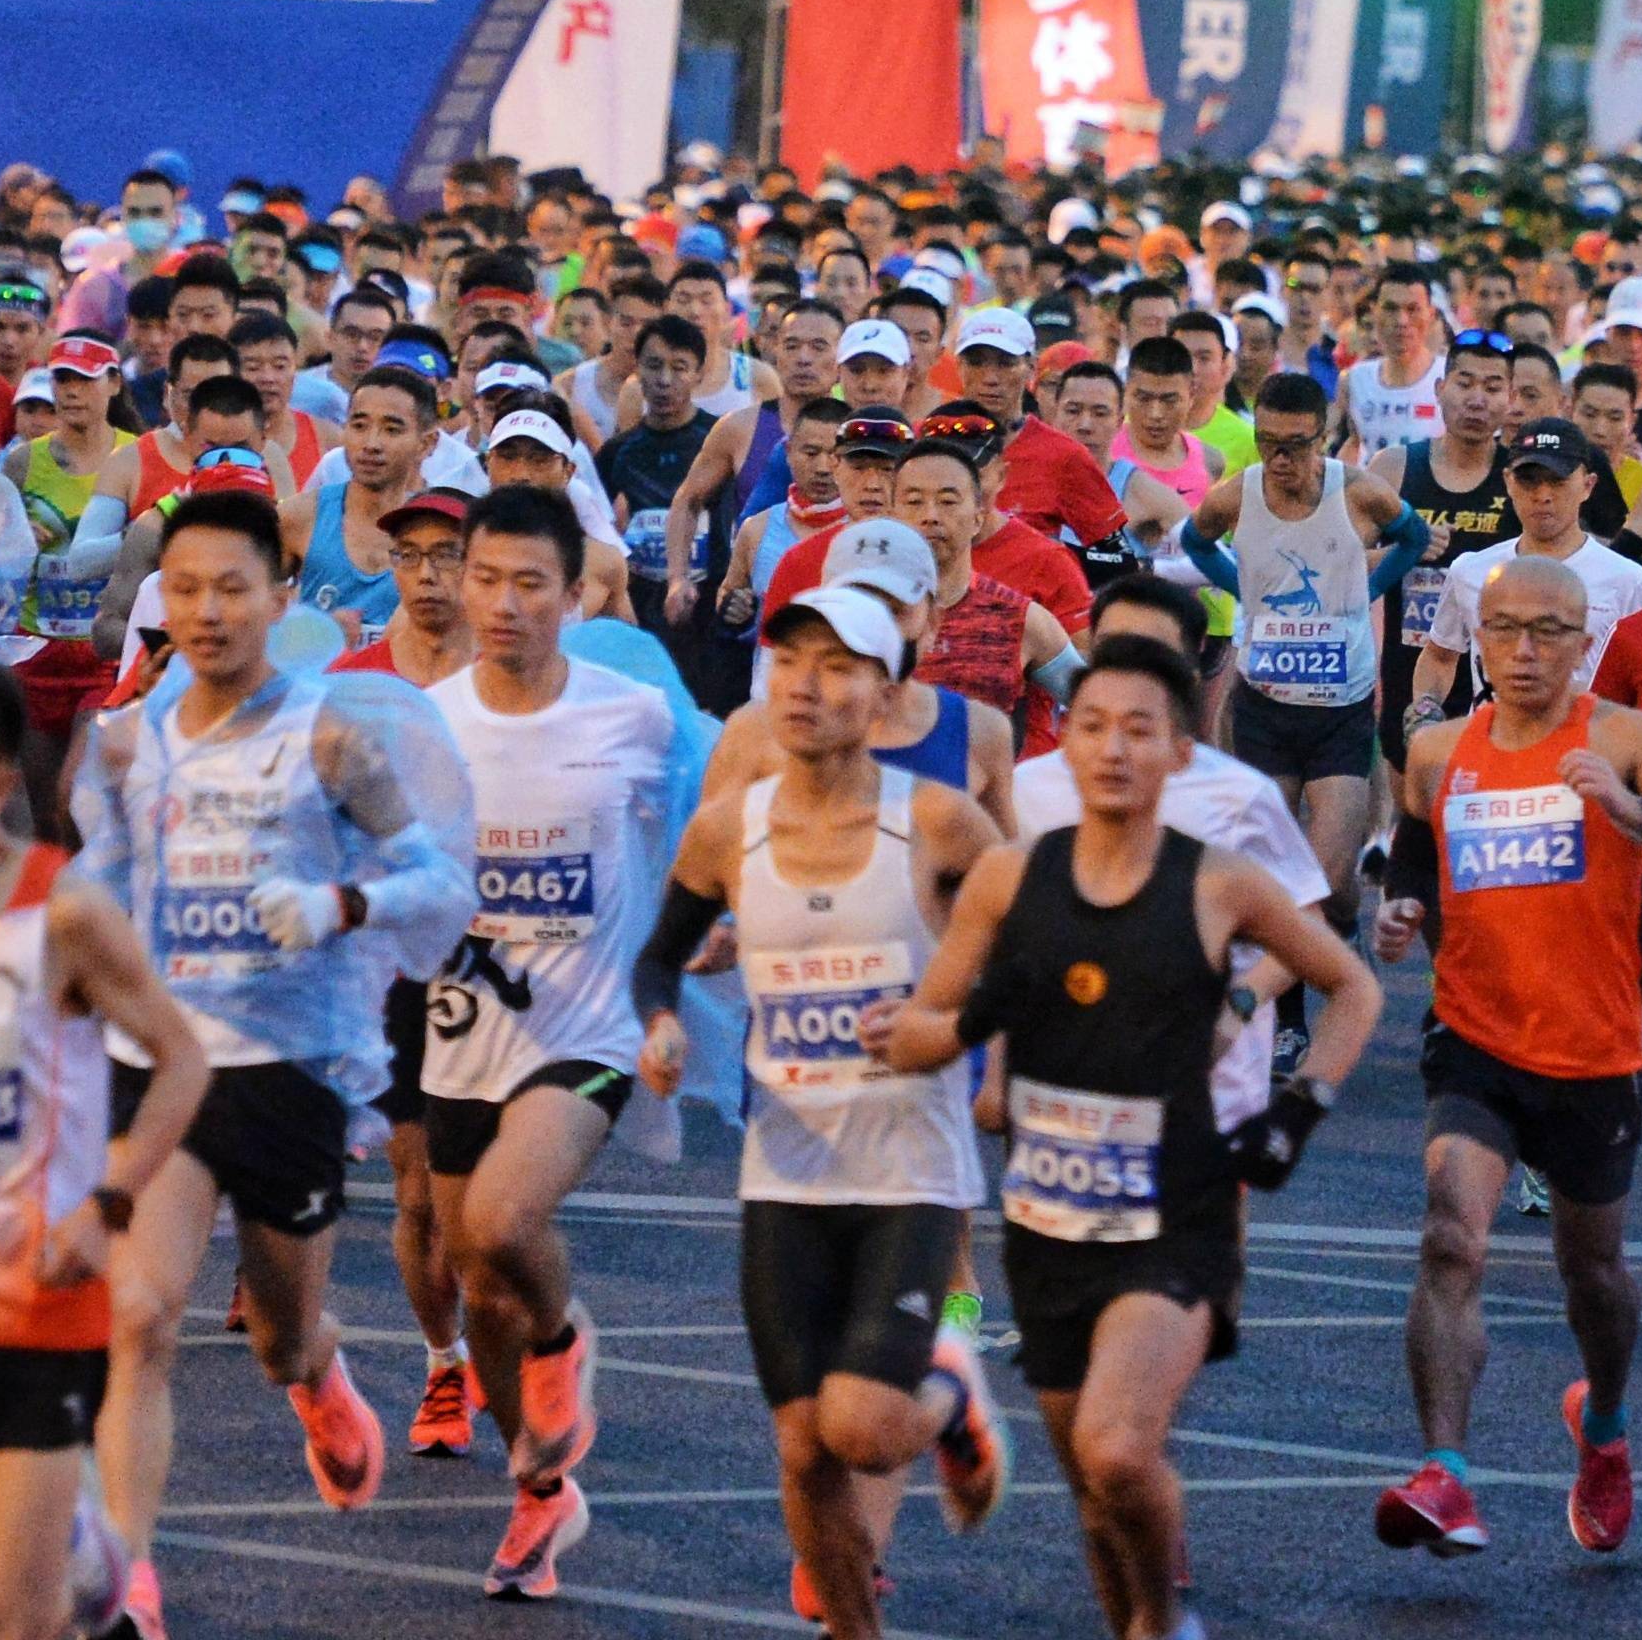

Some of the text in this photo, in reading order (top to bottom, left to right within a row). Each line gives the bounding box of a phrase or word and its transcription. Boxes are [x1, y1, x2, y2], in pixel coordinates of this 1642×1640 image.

[1263, 622, 1333, 637] 东风日产
[1256, 651, 1341, 674] A0122
[1463, 794, 1562, 821] 东风日产
[477, 826, 567, 849] 风日产
[1457, 834, 1577, 876] A1442
[478, 868, 589, 903] 0467
[772, 954, 886, 984] 东风日产
[1007, 1141, 1156, 1198] A0055
